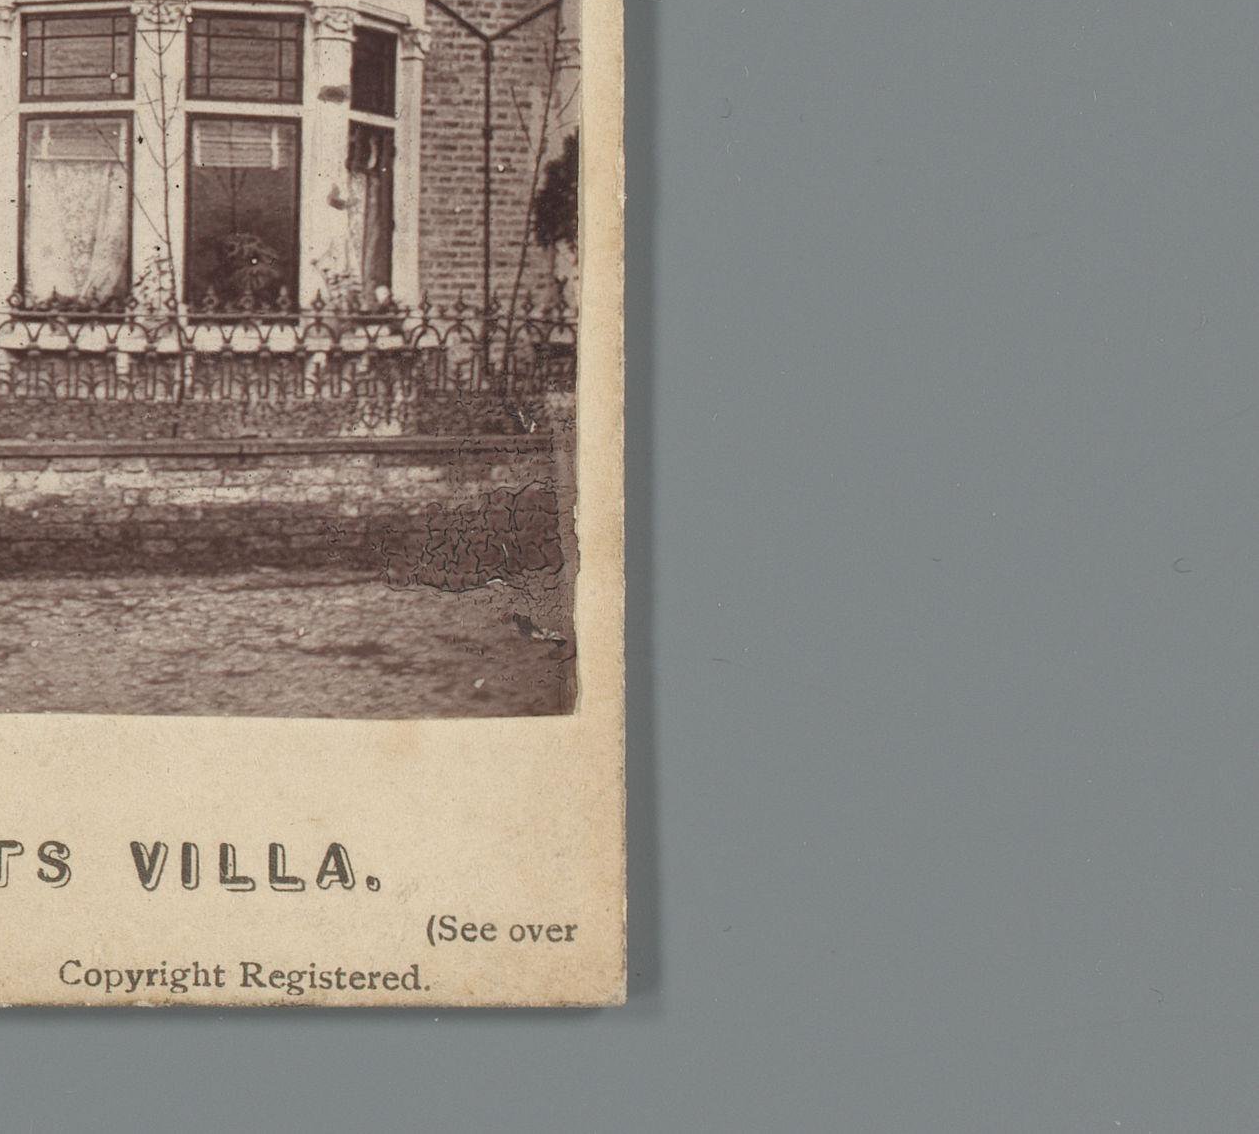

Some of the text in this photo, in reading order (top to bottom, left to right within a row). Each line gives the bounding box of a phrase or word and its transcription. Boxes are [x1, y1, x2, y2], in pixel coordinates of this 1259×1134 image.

[129, 840, 382, 893] VILLA.
[426, 914, 578, 947] (See over
[59, 959, 431, 996] Copyright Registered.
